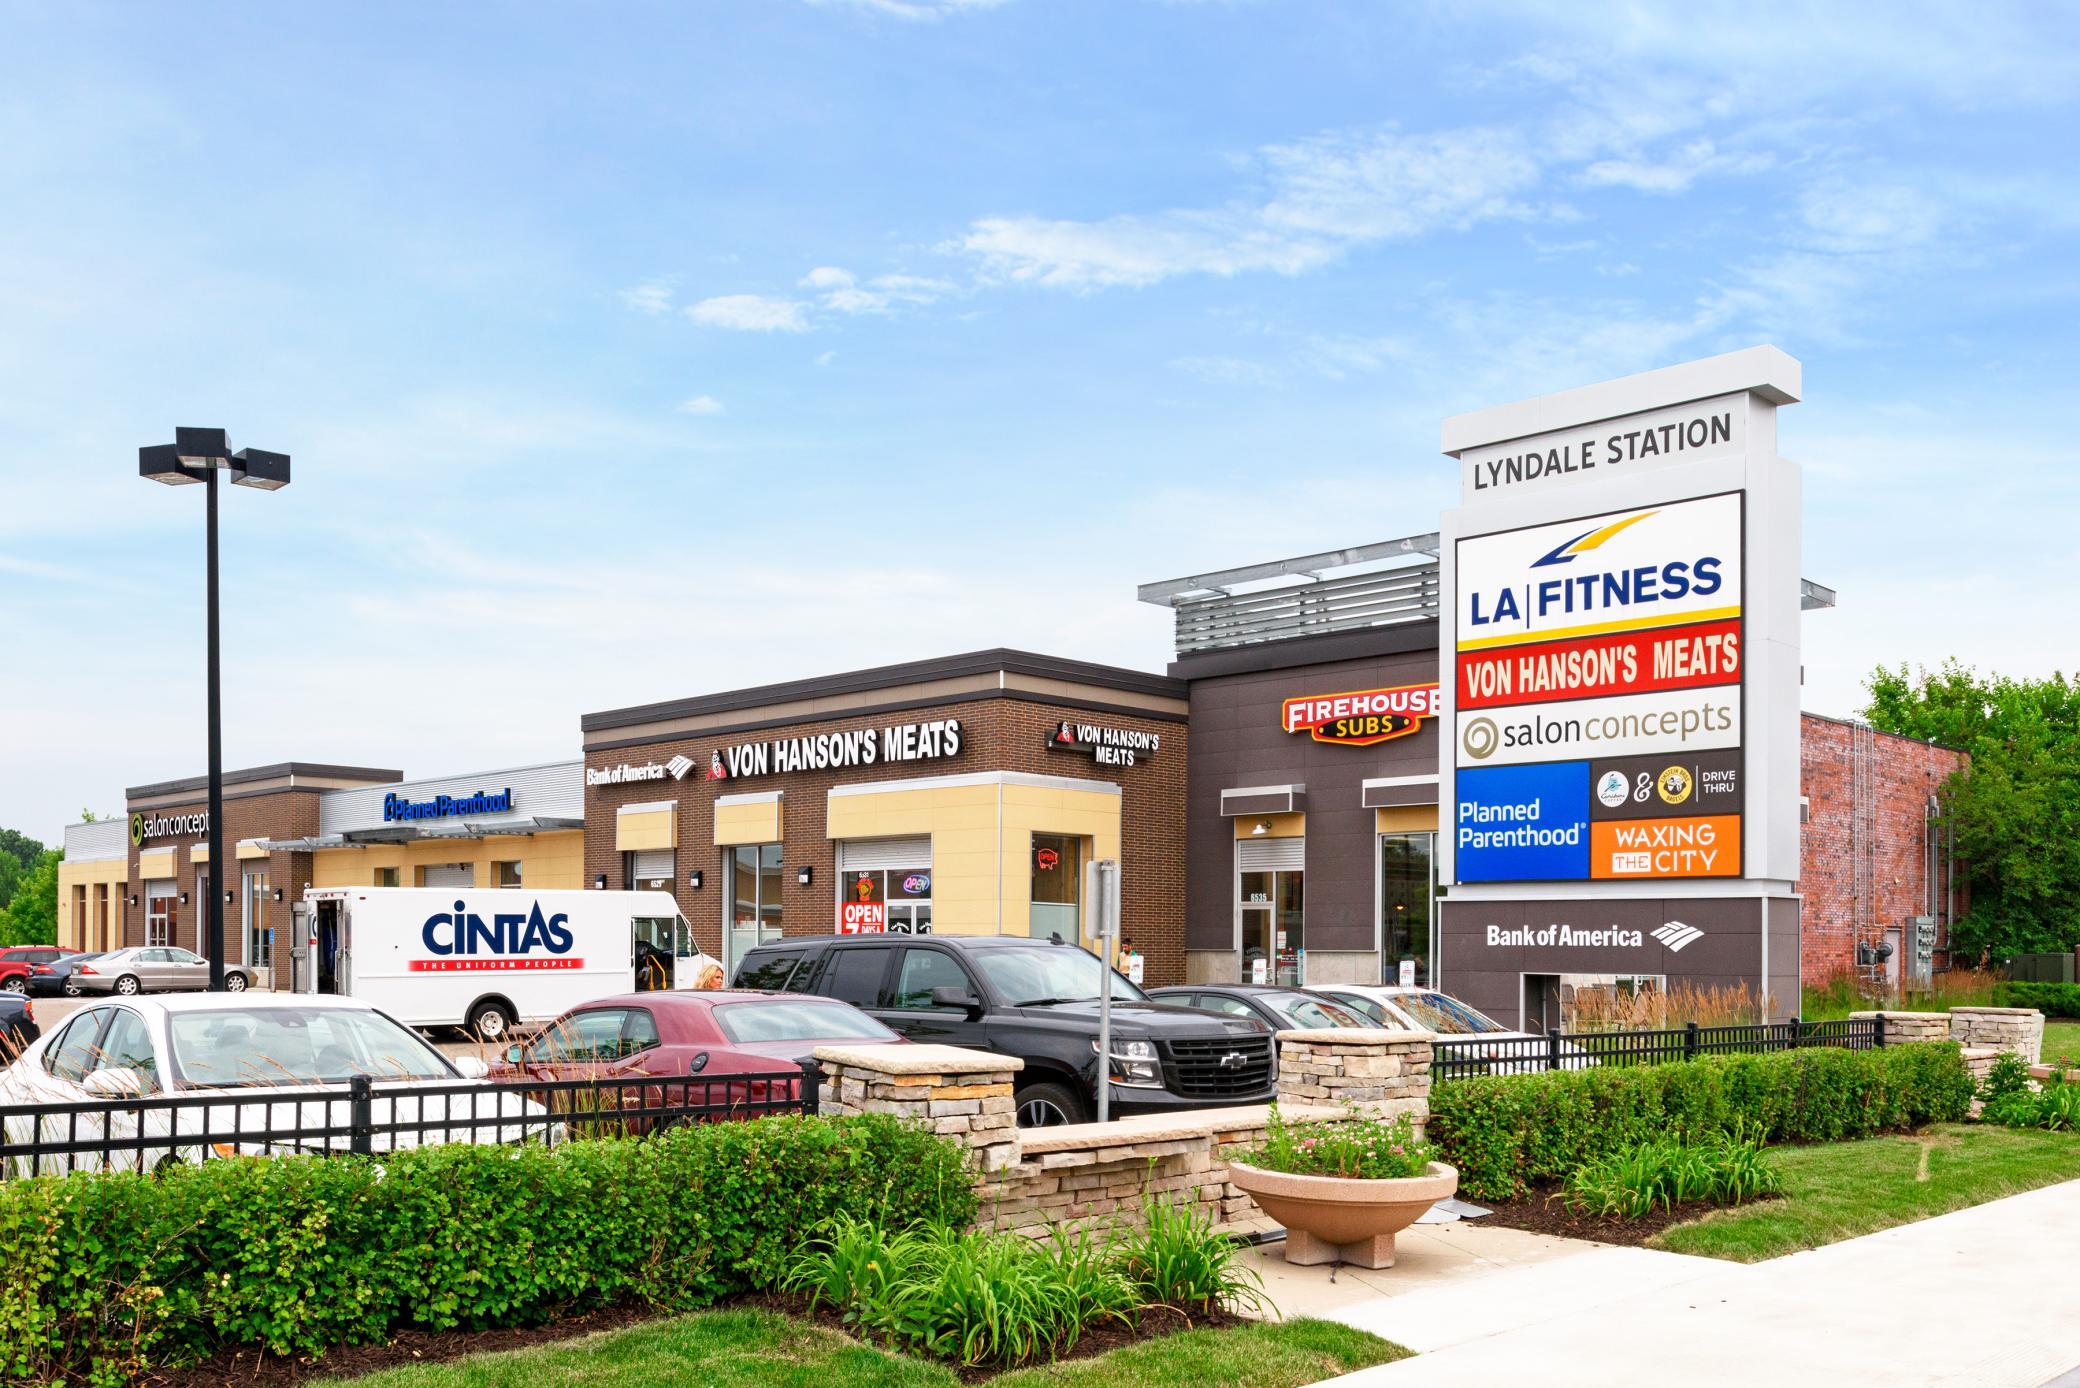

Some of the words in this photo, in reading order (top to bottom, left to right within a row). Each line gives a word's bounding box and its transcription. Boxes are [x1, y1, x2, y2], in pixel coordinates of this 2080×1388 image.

[1474, 440, 1596, 490] LYNDALE
[1607, 413, 1731, 464] STATION
[1471, 587, 1521, 626] LA
[1538, 556, 1723, 617] FITNESS
[1466, 656, 1512, 698] VON
[1519, 644, 1638, 691] HANSON'S
[1653, 632, 1738, 679] MEATS
[1288, 689, 1440, 733] FIREHOUSE
[1077, 724, 1101, 744] VON
[1103, 728, 1160, 751] HANSON'S
[1336, 715, 1393, 737] SUBS
[728, 742, 768, 778] VON
[774, 729, 877, 773] HANSON'S
[884, 719, 959, 762] MEATS
[1096, 746, 1135, 767] MEATS
[587, 766, 611, 785] Bank
[611, 764, 622, 783] of
[622, 762, 664, 782] America
[1702, 770, 1736, 782] DRIVE
[1703, 782, 1735, 794] THRU
[395, 796, 440, 821] Planned
[440, 788, 511, 816] Parenthood
[1459, 798, 1540, 824] Planned
[143, 809, 209, 838] salonconcept
[1459, 822, 1580, 849] Parenthood
[1615, 824, 1716, 848] WAXING
[1615, 855, 1649, 869] THE
[1655, 850, 1718, 872] CITY
[905, 877, 927, 891] OPEN
[845, 904, 883, 922] OPEN
[1486, 924, 1537, 946] Bank
[1537, 924, 1558, 946] of
[1558, 924, 1643, 947] America
[456, 961, 516, 969] UNIFORM
[526, 960, 573, 968] PEOPLE
